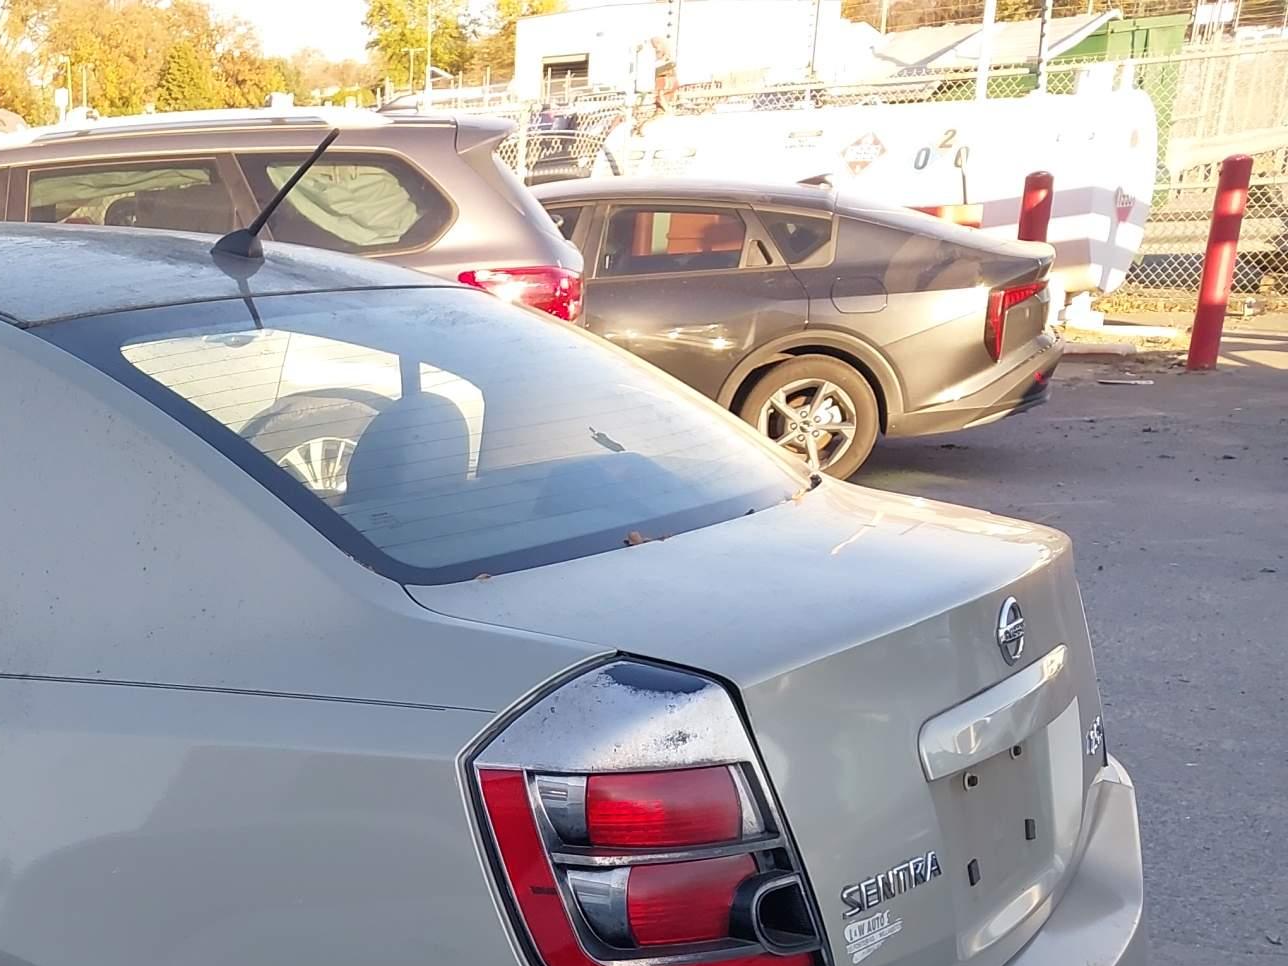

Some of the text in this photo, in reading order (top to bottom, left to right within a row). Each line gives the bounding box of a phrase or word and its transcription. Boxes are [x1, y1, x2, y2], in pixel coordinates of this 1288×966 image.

[938, 129, 958, 149] 2
[913, 147, 931, 170] 0
[841, 851, 942, 919] SENTRA
